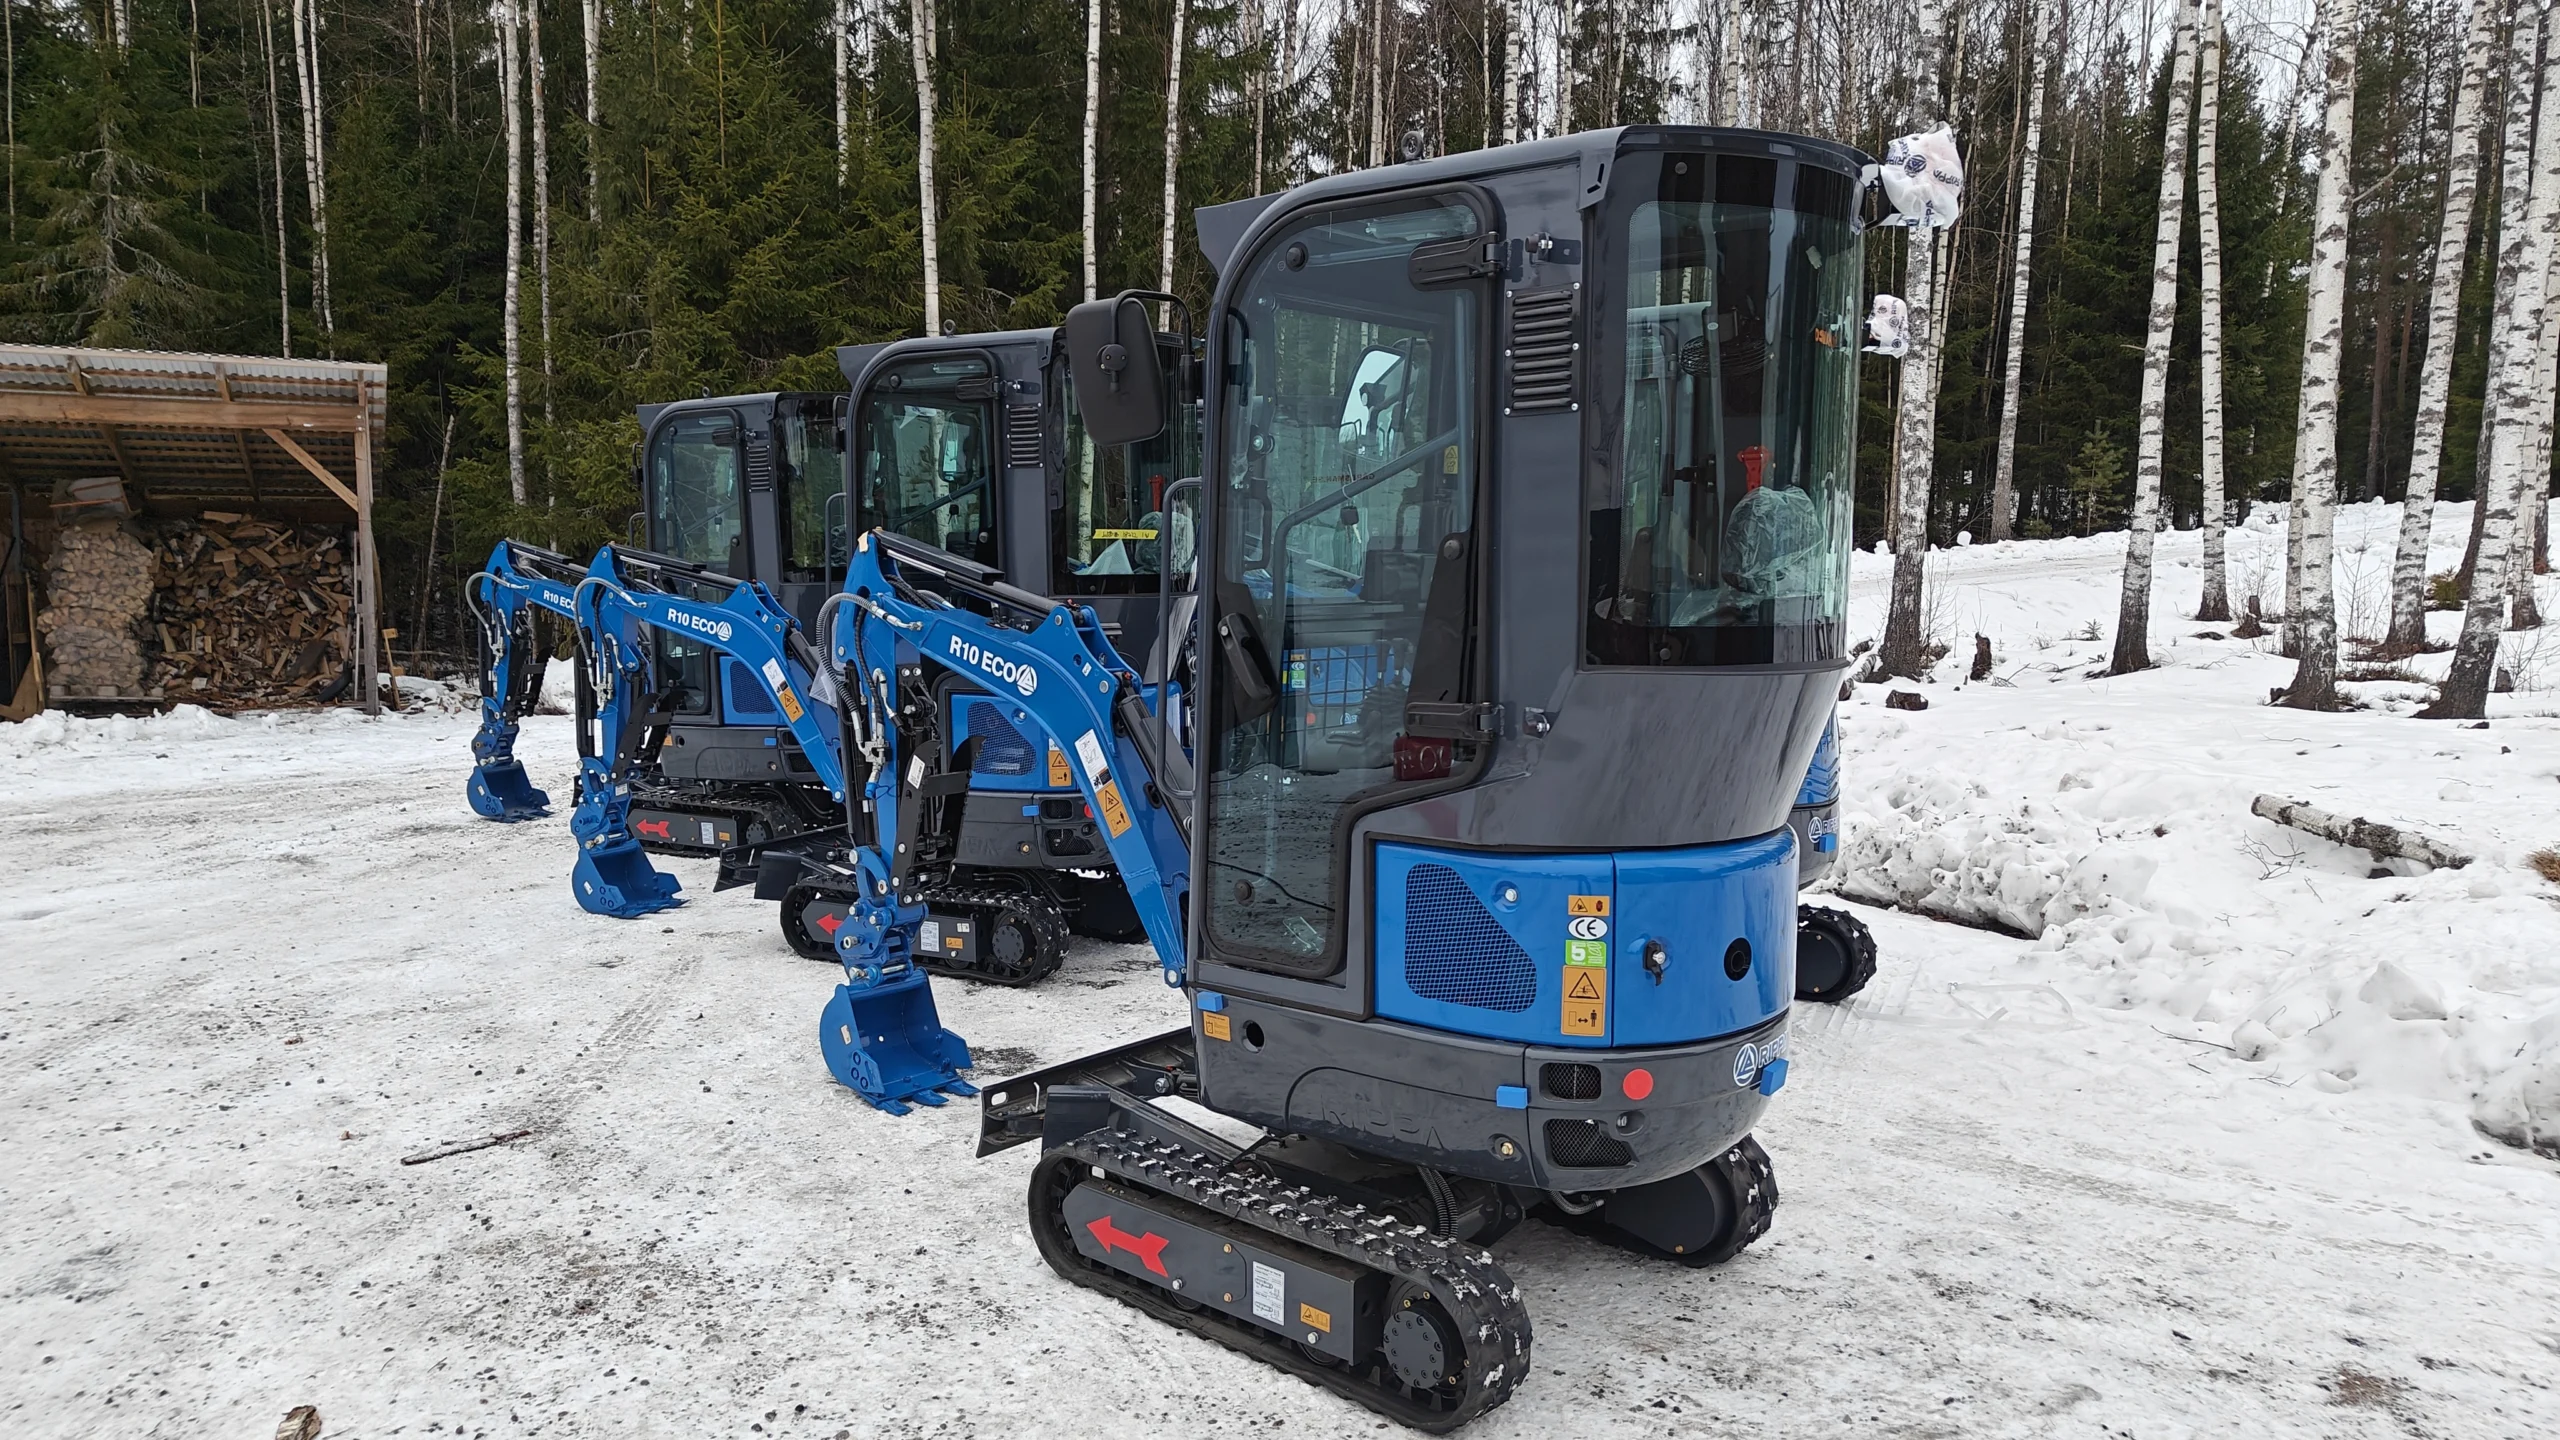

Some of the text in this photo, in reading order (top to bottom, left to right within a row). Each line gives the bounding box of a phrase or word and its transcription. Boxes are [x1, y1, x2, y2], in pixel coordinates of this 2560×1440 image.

[543, 589, 559, 604] R10
[667, 607, 717, 635] R10 ECO
[949, 634, 1017, 684] R10 ECO
[1575, 919, 1598, 938] CE
[1571, 943, 1586, 962] 5
